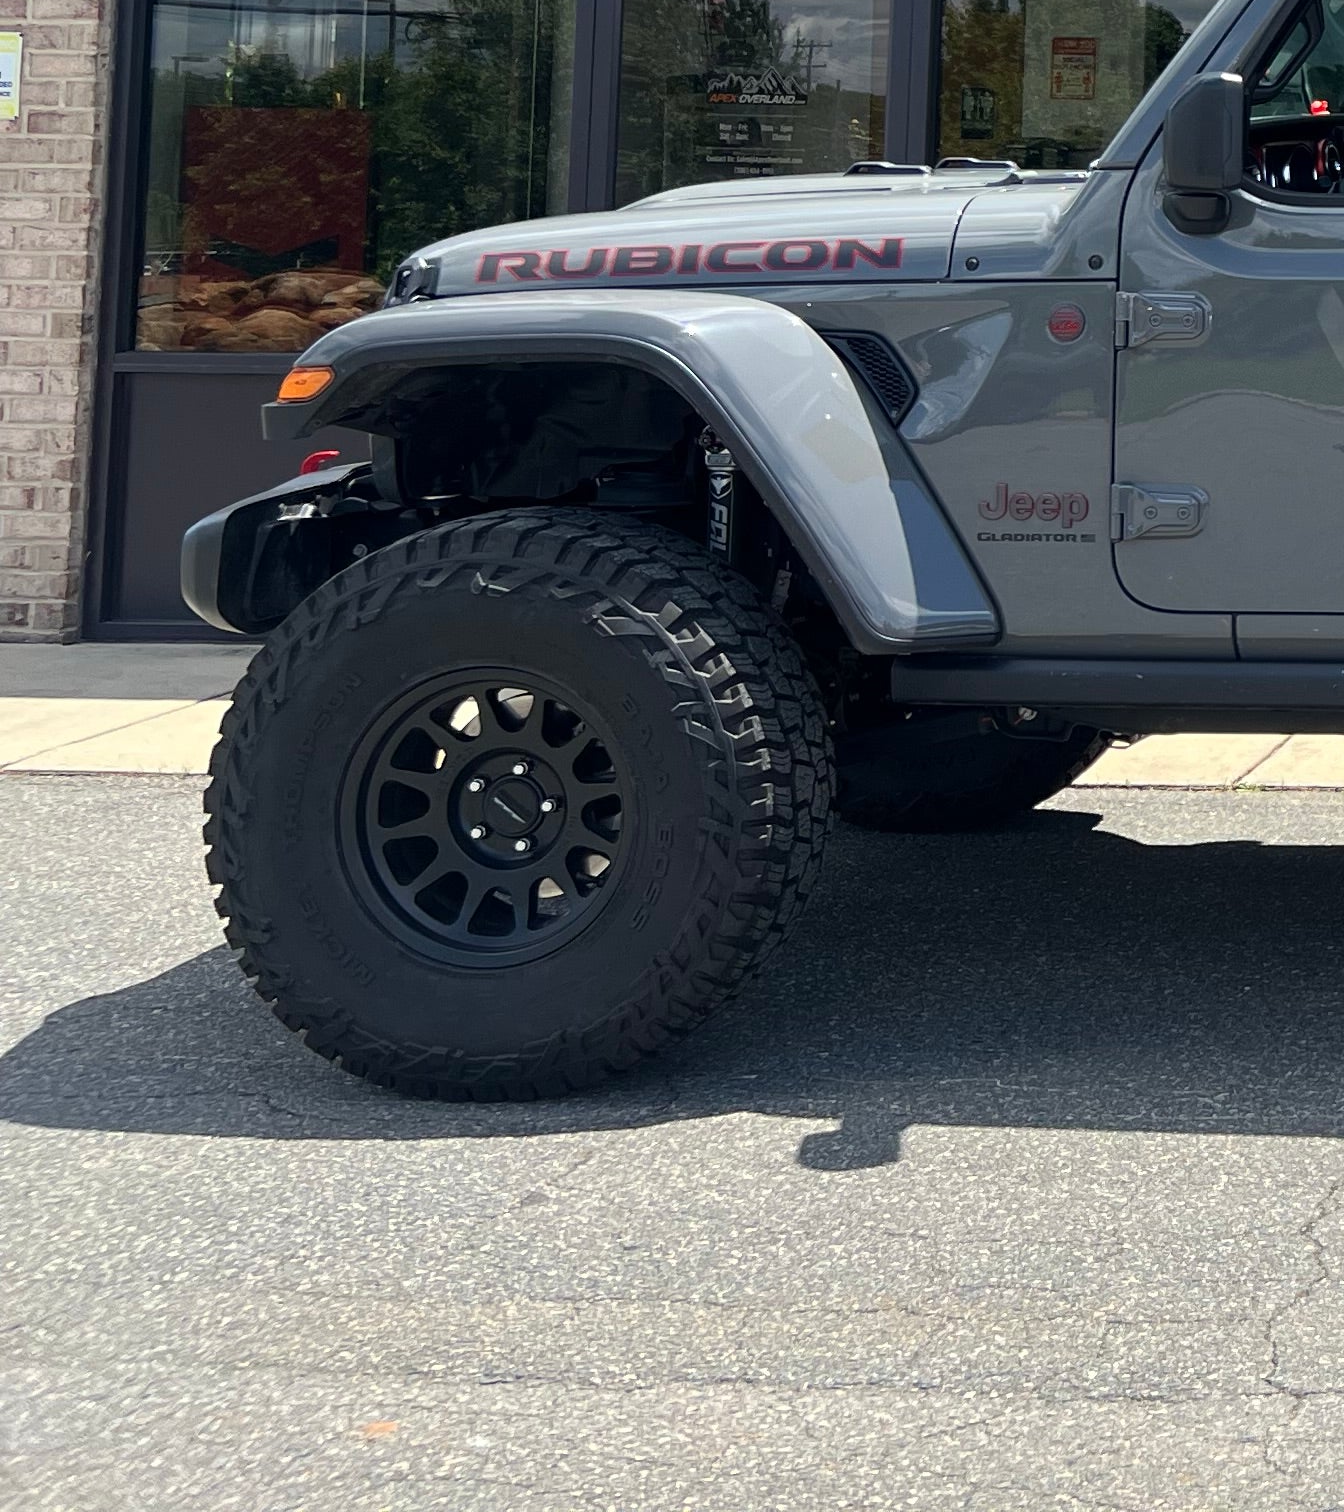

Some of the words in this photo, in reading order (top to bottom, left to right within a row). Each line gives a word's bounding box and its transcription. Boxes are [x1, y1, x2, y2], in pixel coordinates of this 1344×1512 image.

[709, 93, 736, 103] APEX
[475, 238, 905, 284] RUBICON
[978, 482, 1090, 529] Jeep
[977, 532, 1077, 543] GLADIATOR
[630, 824, 675, 932] BOSS
